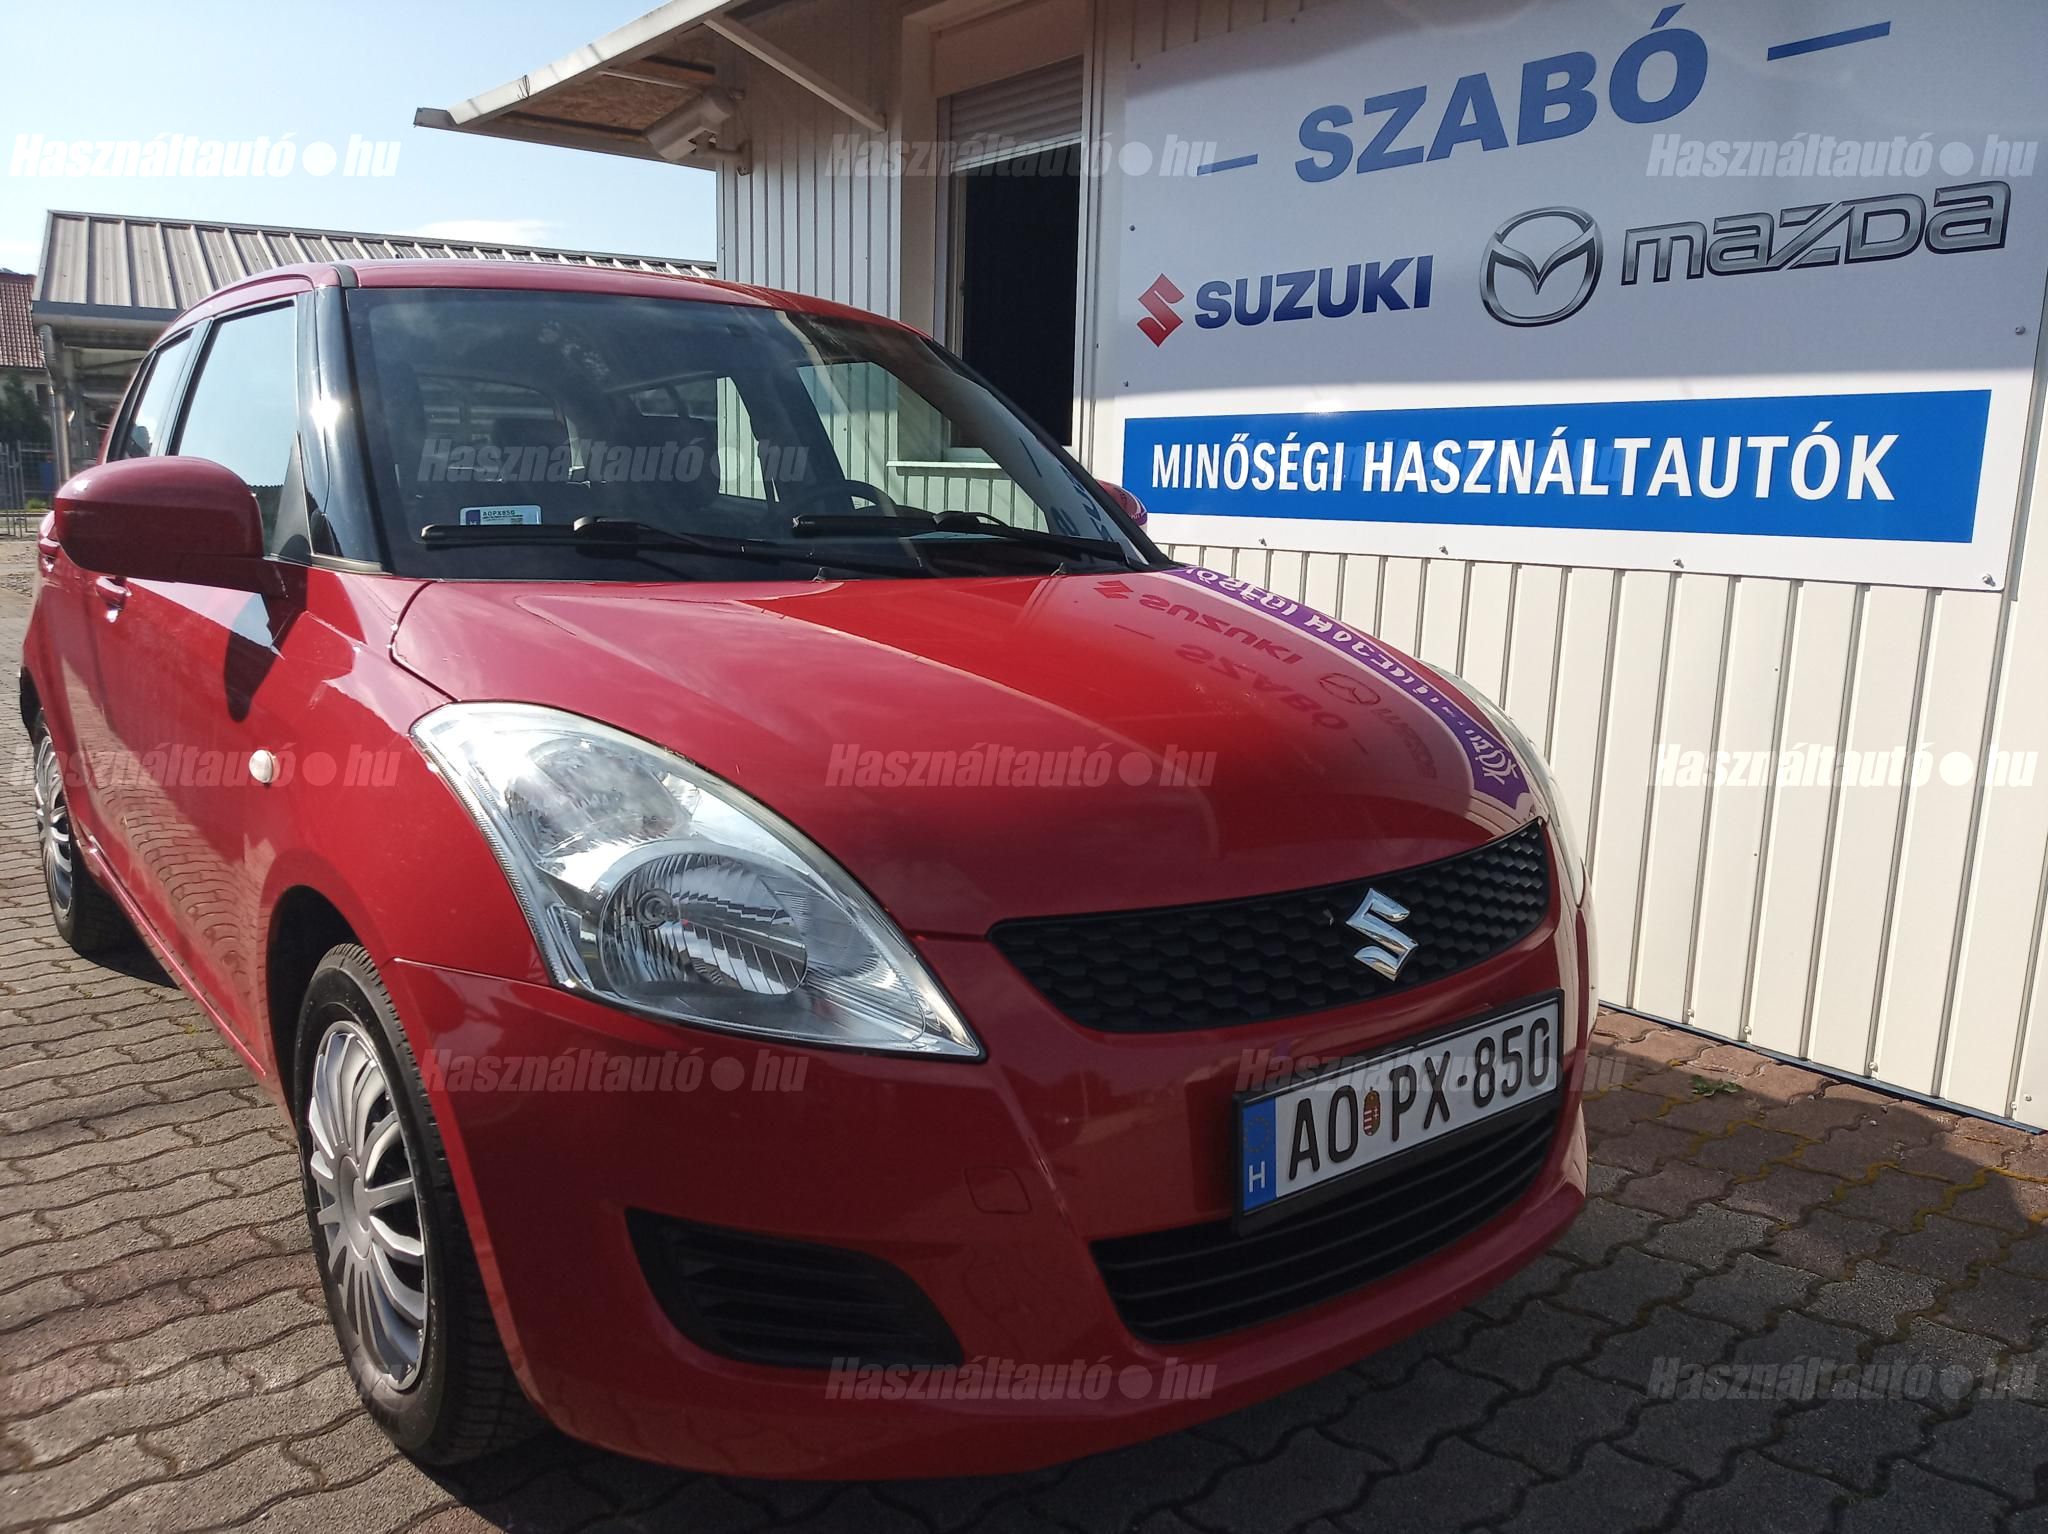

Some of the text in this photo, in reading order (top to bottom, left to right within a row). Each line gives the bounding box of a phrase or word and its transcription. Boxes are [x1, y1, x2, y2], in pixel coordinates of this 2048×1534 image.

[1295, 3, 1708, 182] SZABÓ
[1195, 255, 1433, 329] SUZUKI
[1152, 432, 1344, 491] MINŐSÉGI
[1362, 421, 1900, 500] HASZNÁLTAUTÓK
[1248, 1160, 1266, 1193] H
